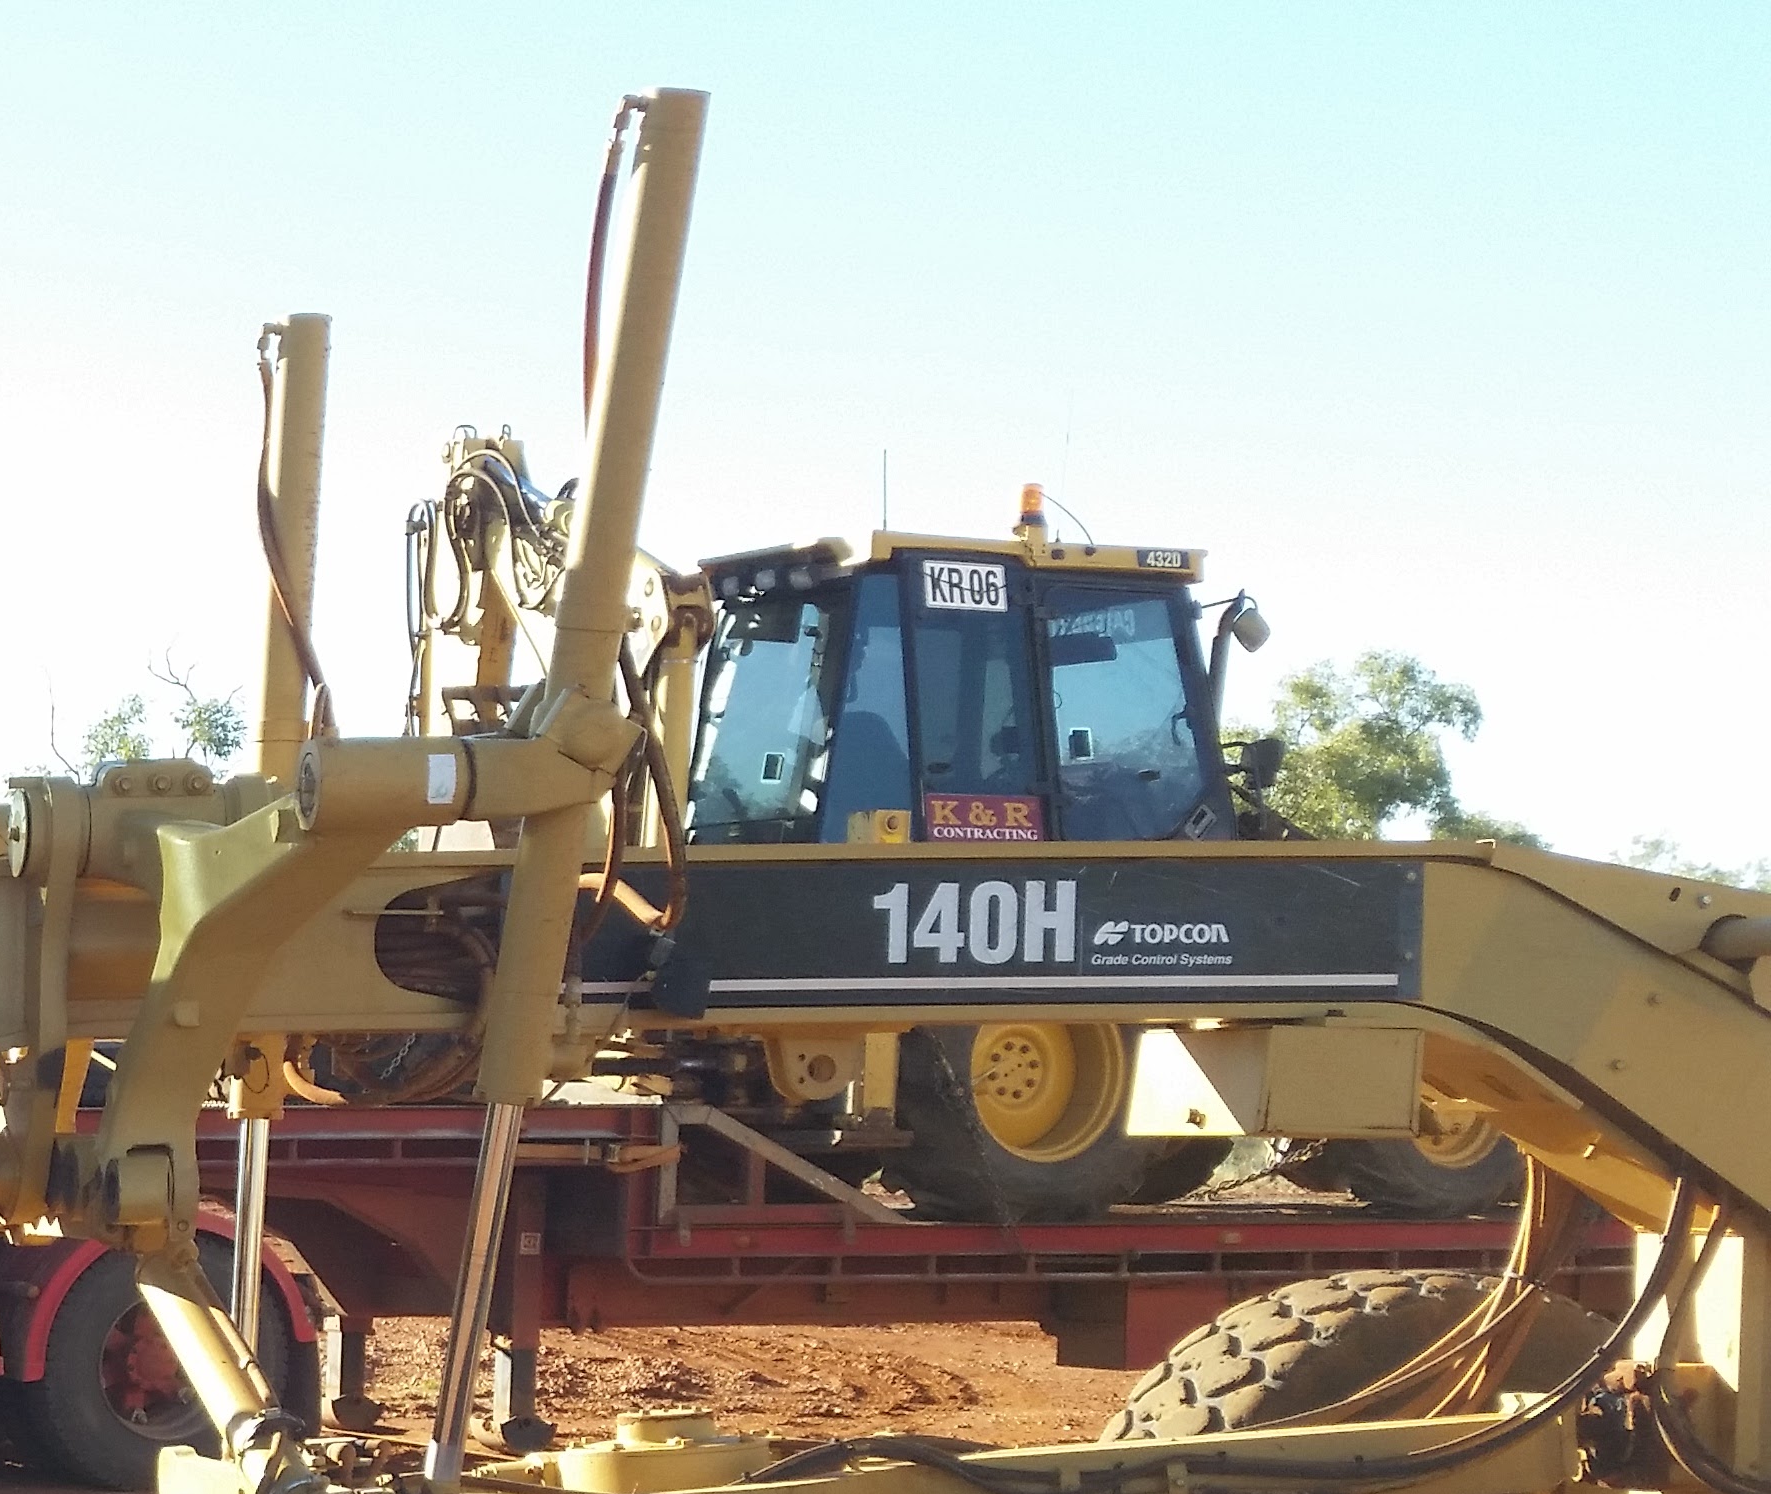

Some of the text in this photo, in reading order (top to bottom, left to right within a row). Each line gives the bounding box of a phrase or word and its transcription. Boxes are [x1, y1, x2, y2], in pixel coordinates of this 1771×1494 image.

[1146, 550, 1182, 569] 432D
[930, 565, 1000, 607] KR06
[931, 800, 1033, 827] K & R
[933, 827, 1038, 840] CONTRACTING
[872, 879, 1077, 965] 140H
[1130, 922, 1230, 944] TOPCON
[1091, 953, 1233, 967] Grade Control Systems
